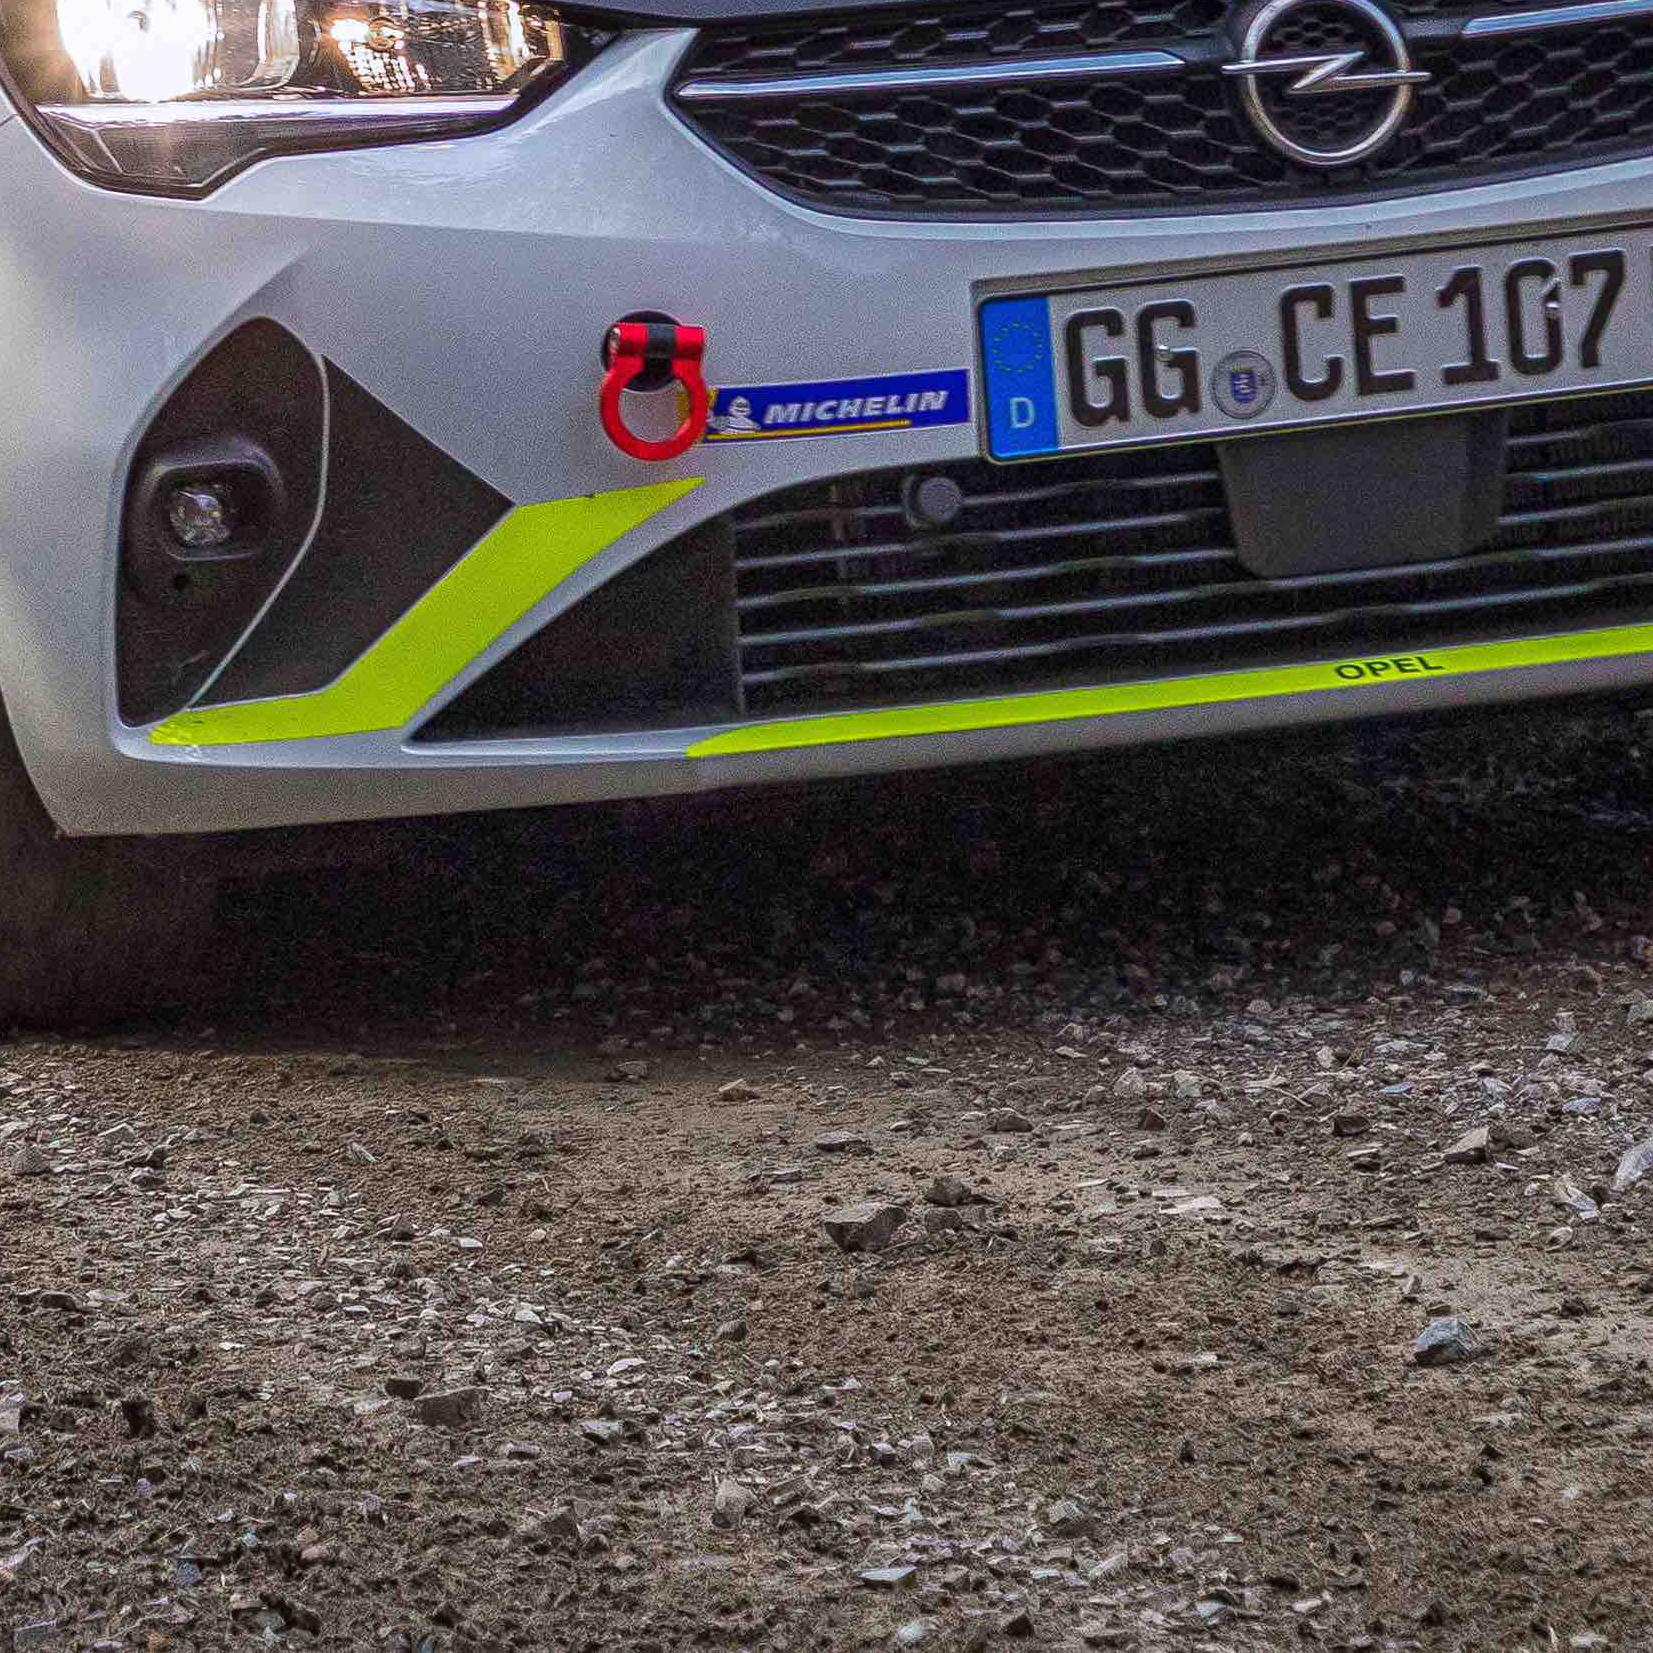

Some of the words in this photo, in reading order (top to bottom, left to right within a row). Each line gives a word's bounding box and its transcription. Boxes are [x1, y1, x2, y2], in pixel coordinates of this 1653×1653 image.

[1065, 298, 1203, 428] GG
[762, 390, 949, 425] MICHELIN
[1009, 396, 1035, 429] D
[1335, 656, 1446, 680] OPEL
